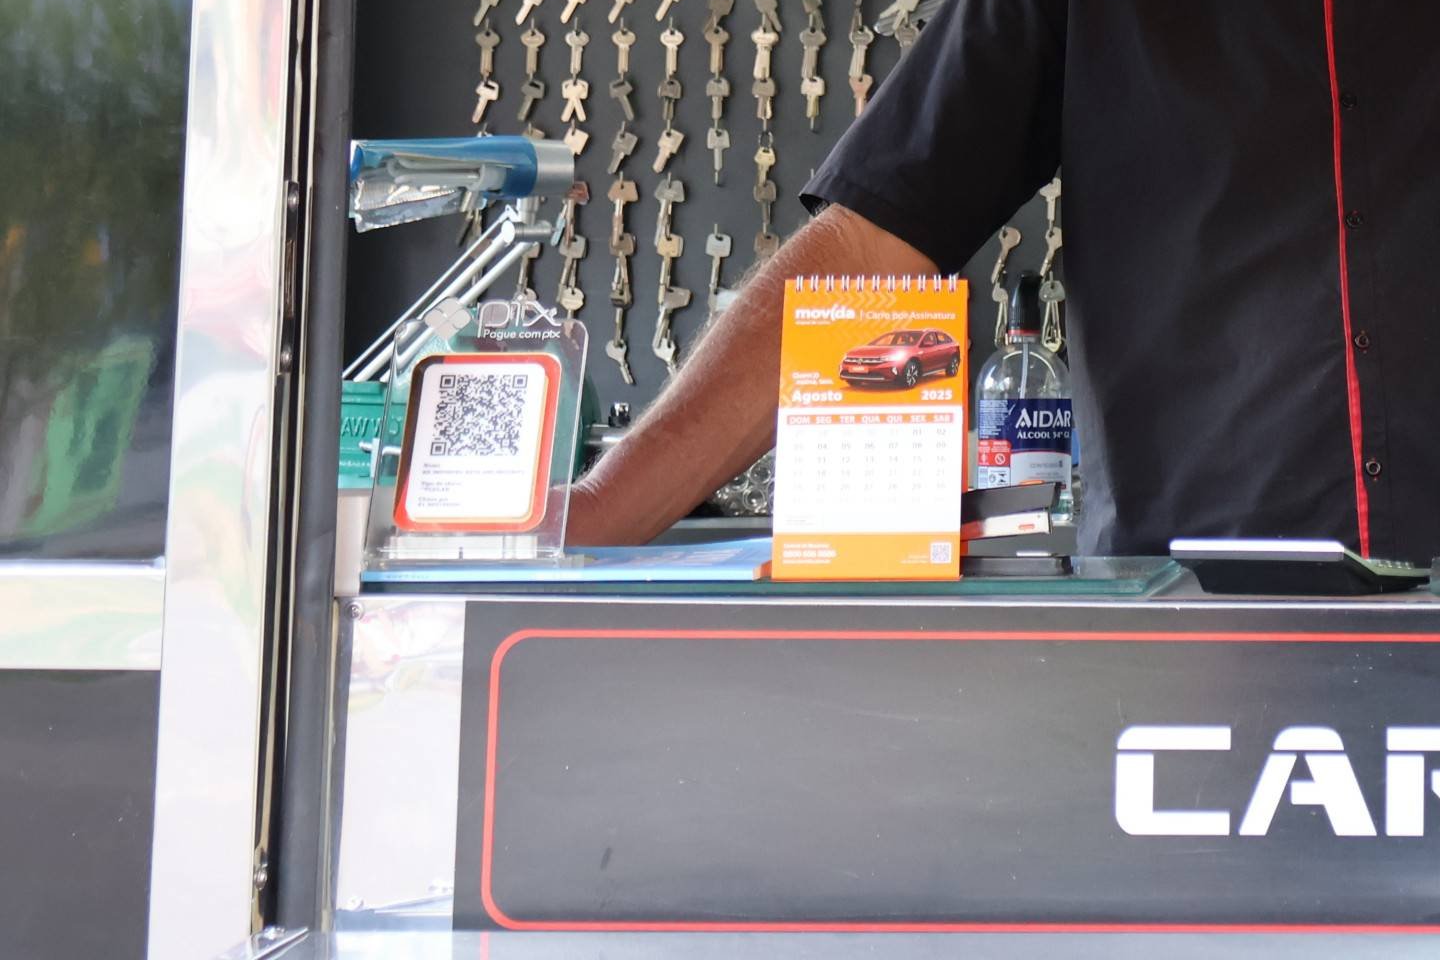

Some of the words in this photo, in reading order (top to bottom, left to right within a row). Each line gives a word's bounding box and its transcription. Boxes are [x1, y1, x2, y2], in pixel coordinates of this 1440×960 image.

[477, 300, 562, 339] pix
[795, 304, 856, 322] movida
[910, 311, 955, 320] Assinatura
[484, 329, 517, 341] Pague
[519, 331, 542, 339] com
[792, 389, 843, 404] Agosto
[921, 389, 952, 401] 2025
[790, 416, 811, 425] DOM
[816, 416, 833, 424] SEG
[862, 415, 880, 424] QUA
[886, 415, 903, 423] QUI
[1016, 408, 1071, 429] AIDAR
